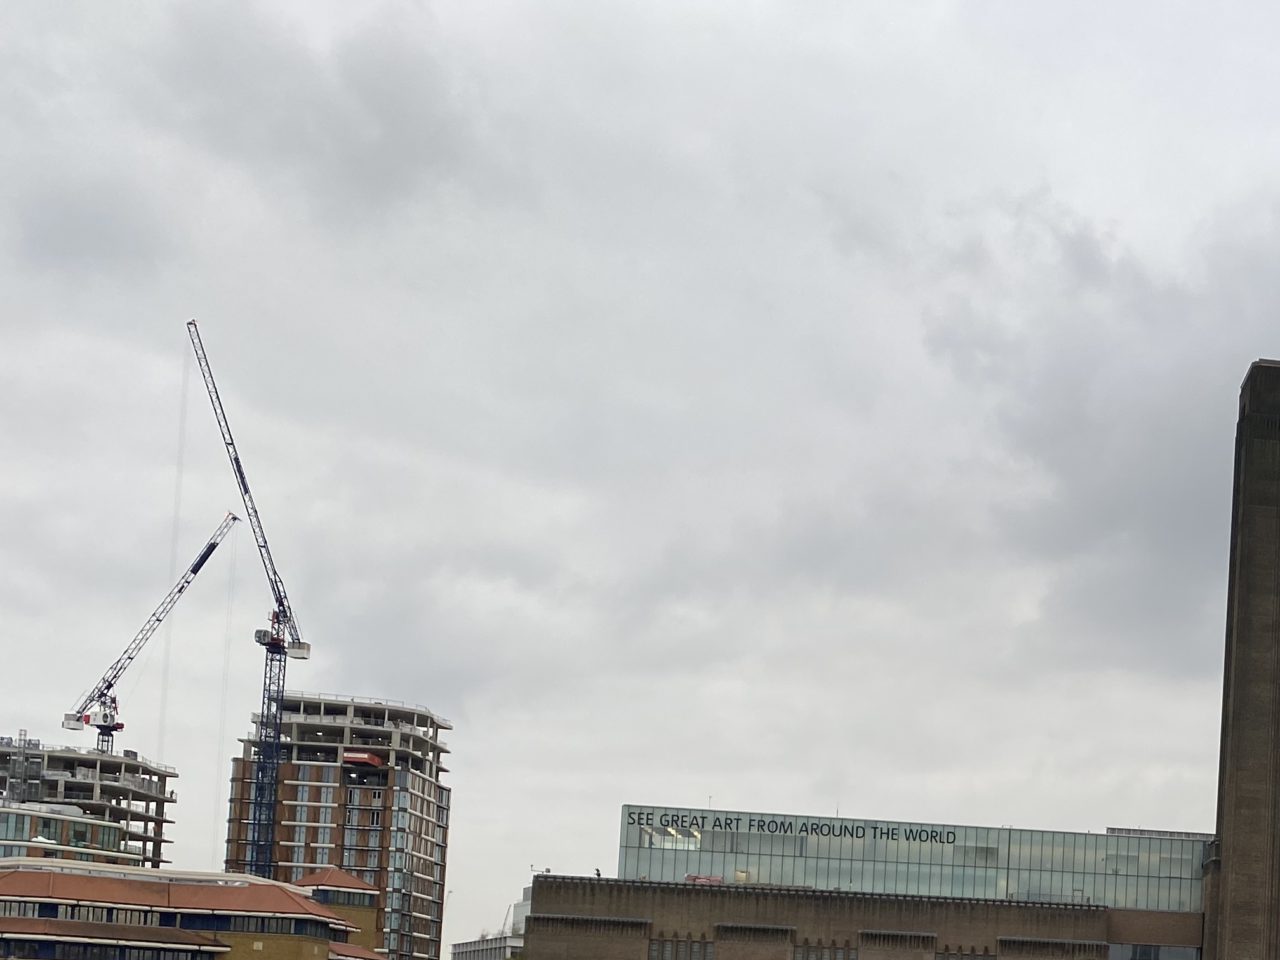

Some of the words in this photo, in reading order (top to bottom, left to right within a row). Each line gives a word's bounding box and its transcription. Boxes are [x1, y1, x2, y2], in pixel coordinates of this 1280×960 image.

[627, 811, 654, 826] SEE
[659, 813, 708, 829] GREAT
[711, 817, 742, 831] ART
[748, 819, 793, 834] FROM
[798, 822, 866, 839] AROUND
[870, 826, 899, 841] THE
[904, 828, 956, 844] WORLD
